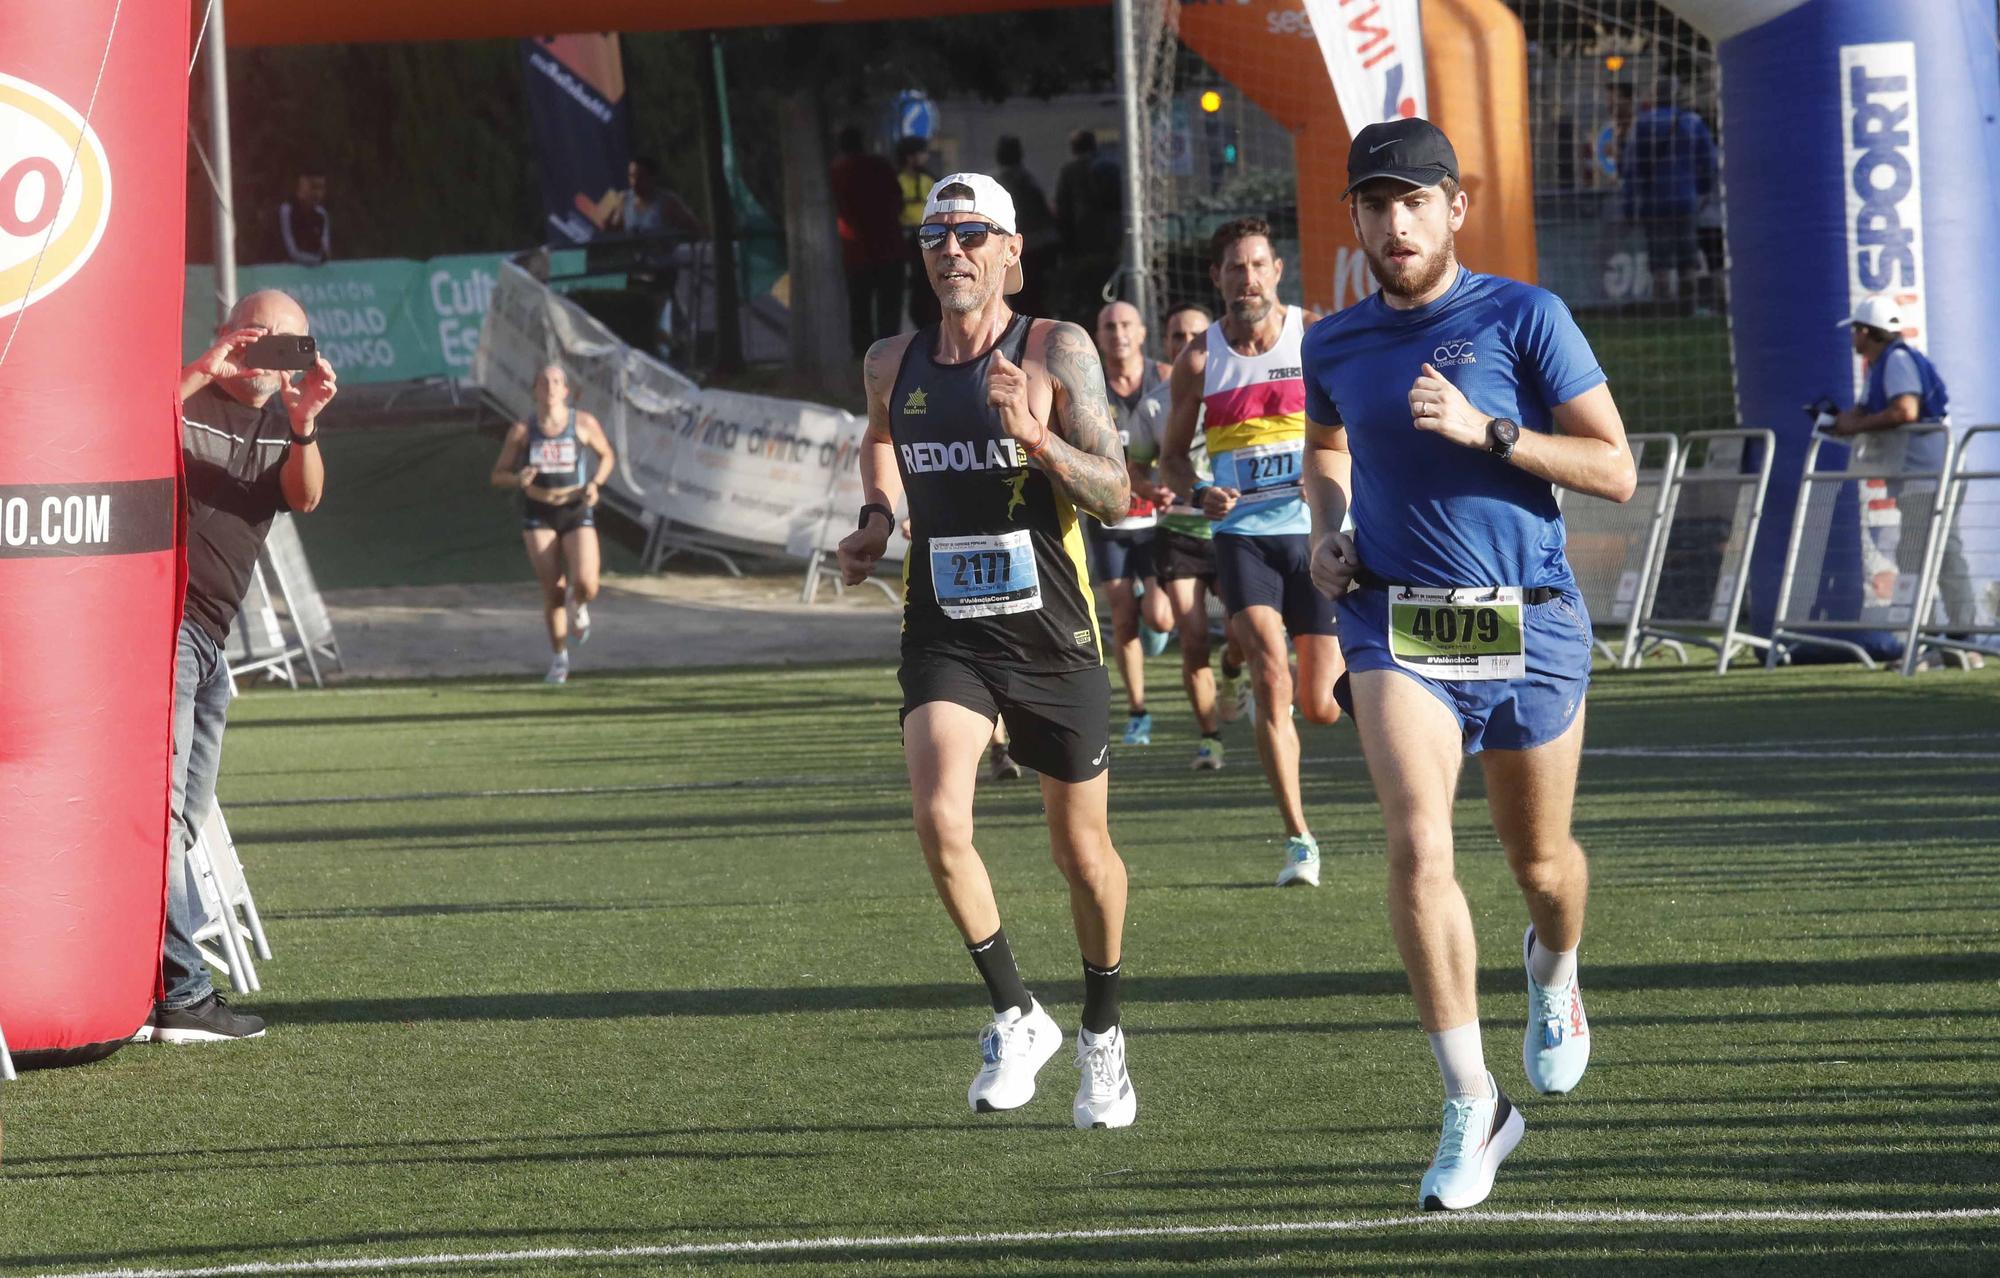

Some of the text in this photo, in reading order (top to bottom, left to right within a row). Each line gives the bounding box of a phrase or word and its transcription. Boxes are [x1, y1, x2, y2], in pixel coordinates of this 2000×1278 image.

[1266, 10, 1316, 38] seg
[1850, 66, 1917, 335] SPORT
[431, 269, 497, 315] Cult
[308, 306, 387, 337] NIDAD
[323, 338, 394, 369] ONSO
[438, 318, 481, 366] Es
[903, 406, 927, 415] luanvi
[900, 438, 1019, 475] REDOLAT
[1248, 454, 1293, 480] 2277
[0, 494, 111, 546] O.COM
[951, 551, 1011, 586] 2177
[1412, 607, 1499, 643] 4079
[1427, 655, 1479, 664] #ValènciaCor
